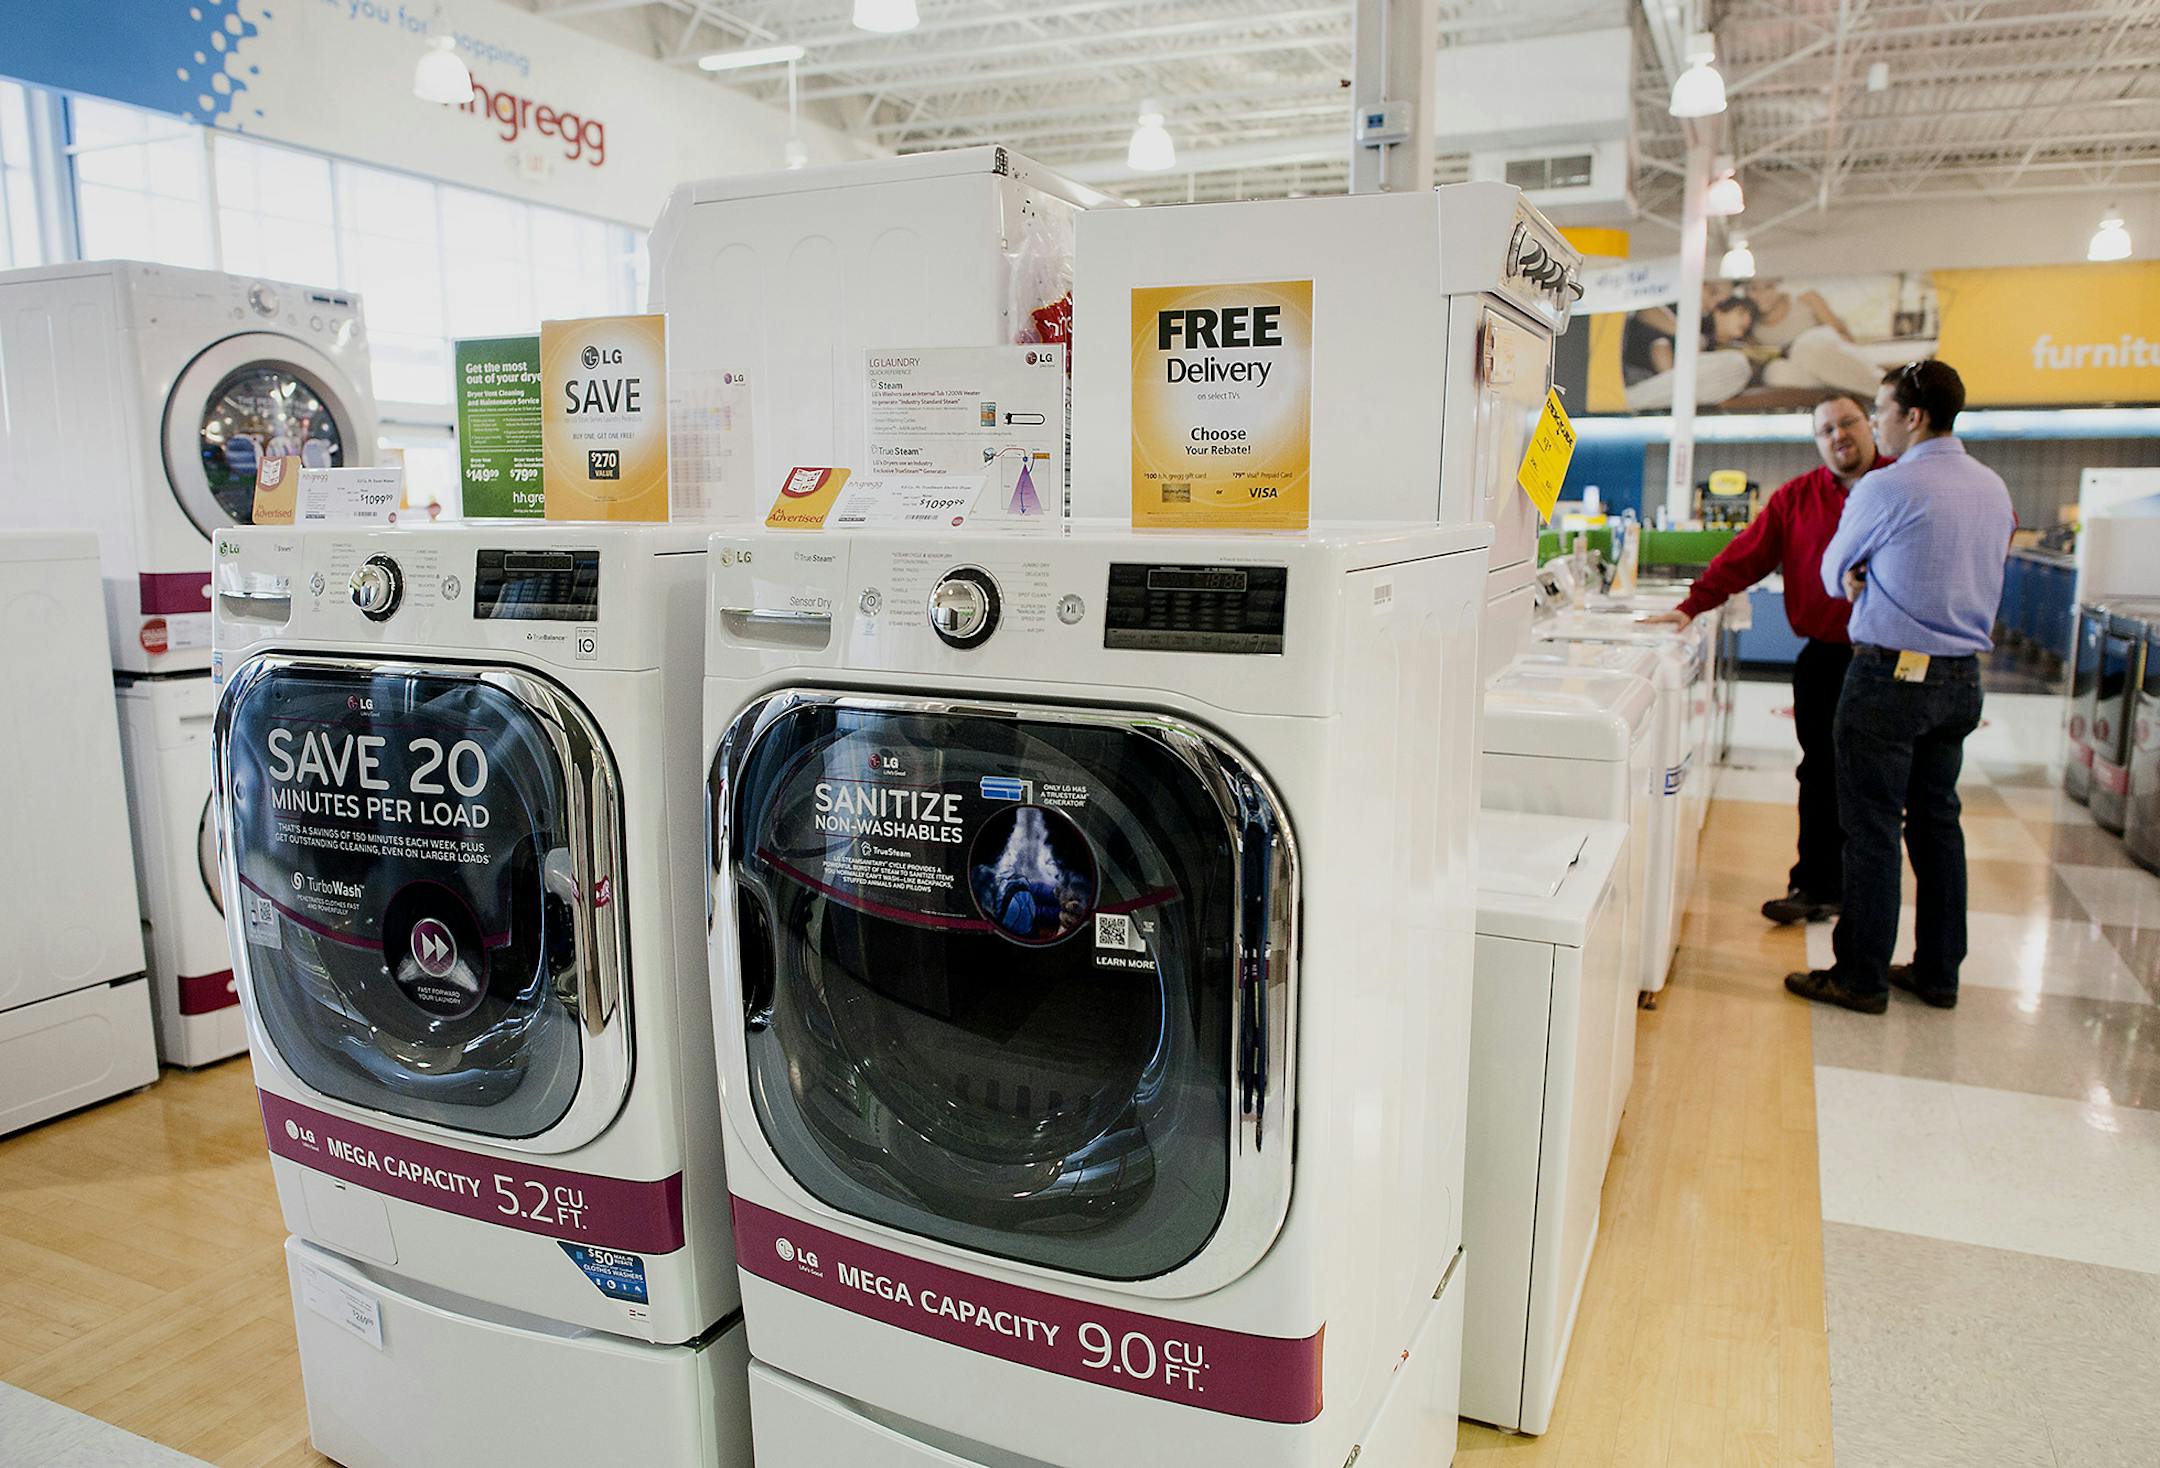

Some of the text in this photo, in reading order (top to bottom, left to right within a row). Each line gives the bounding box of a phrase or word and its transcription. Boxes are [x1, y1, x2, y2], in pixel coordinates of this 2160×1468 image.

[1158, 306, 1282, 350] FREE
[603, 349, 623, 364] LG
[881, 358, 920, 367] LAUNDRY
[1039, 353, 1053, 362] LG
[465, 362, 527, 373] Get the most
[1167, 356, 1272, 388] Delivery
[466, 375, 482, 384] out
[485, 374, 495, 384] of
[497, 374, 519, 385] your
[878, 381, 903, 390] Steam
[517, 397, 539, 405] Service
[565, 378, 641, 414] SAVE
[1208, 391, 1227, 400] select
[1228, 391, 1240, 400] TVs
[1190, 427, 1247, 441] Choose
[1185, 445, 1251, 455] Your Rebate!
[591, 452, 617, 468] $270
[1249, 487, 1278, 498] VISA
[255, 508, 293, 519] Advertised
[769, 513, 824, 523] Advertised
[736, 551, 752, 563] LG
[790, 596, 832, 609] Sensor Dry
[360, 698, 373, 710] LG
[268, 728, 489, 798] SAVE 20
[883, 757, 899, 768] LG
[1043, 783, 1061, 791] ONLY
[1072, 785, 1087, 793] HAS
[271, 786, 490, 829] MINUTES PER LOAD
[815, 783, 963, 824] SANITIZE
[815, 814, 963, 844] NON-WASHABLES
[278, 822, 485, 853] THAT'S A SAVINGS OF 150 MINUTES EACH WEEK, PLUS
[275, 832, 288, 842] GET
[289, 834, 339, 849] OUTSTANDING
[339, 841, 381, 856] CLEANING,
[381, 845, 404, 857] EVEN
[405, 848, 418, 858] ON
[420, 849, 456, 862] LARGER
[873, 846, 912, 858] TrueSteam
[852, 864, 871, 872] BURST
[881, 867, 900, 876] STEAM
[909, 871, 935, 880] SANITIZE
[889, 861, 906, 870] CYCLE
[907, 864, 936, 873] PROVIDES
[865, 872, 882, 880] CAN'T
[843, 876, 867, 885] STUFFED
[868, 880, 892, 888] ANIMALS
[905, 884, 932, 893] PILLOWS
[347, 902, 360, 910] FAST
[1096, 956, 1155, 970] LEARN MORE
[417, 986, 460, 998] FAST FORWARD
[418, 993, 461, 1004] YOUR LAUNDRY
[300, 1127, 316, 1144] LG
[326, 1136, 589, 1223] MEGA CAPACITY 5.2 CU.
[557, 1206, 588, 1230] FT.
[588, 1248, 614, 1266] $50
[797, 1247, 819, 1268] LG
[583, 1263, 612, 1275] CLOTHES
[612, 1270, 643, 1281] WASHERS
[837, 1262, 1211, 1380] MEGA CAPACITY 9.0 CU.
[1165, 1363, 1205, 1392] FT.
